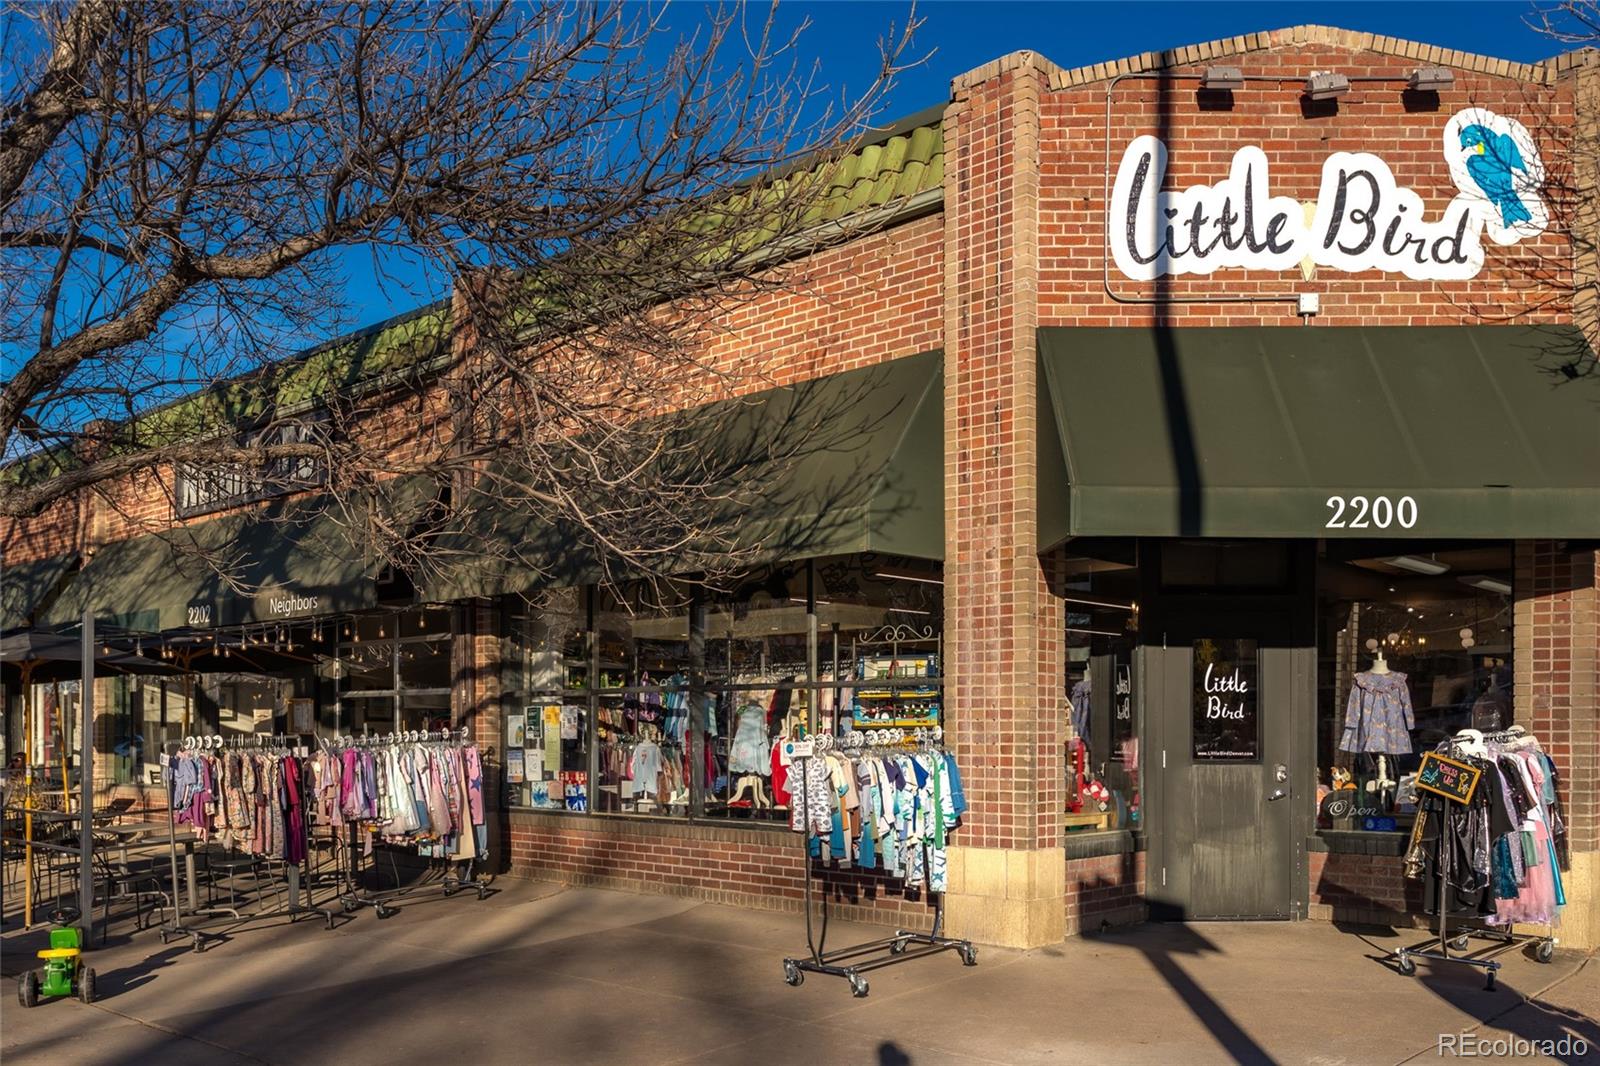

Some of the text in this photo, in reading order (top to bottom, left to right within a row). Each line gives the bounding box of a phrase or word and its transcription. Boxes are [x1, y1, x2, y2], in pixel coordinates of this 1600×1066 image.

[1125, 151, 1470, 265] Little Bird
[1325, 495, 1418, 529] 2200
[187, 604, 211, 624] 2202
[269, 595, 318, 617] Neighbors
[1204, 662, 1248, 693] Little
[1206, 695, 1245, 720] Bird
[1327, 800, 1377, 821] Open
